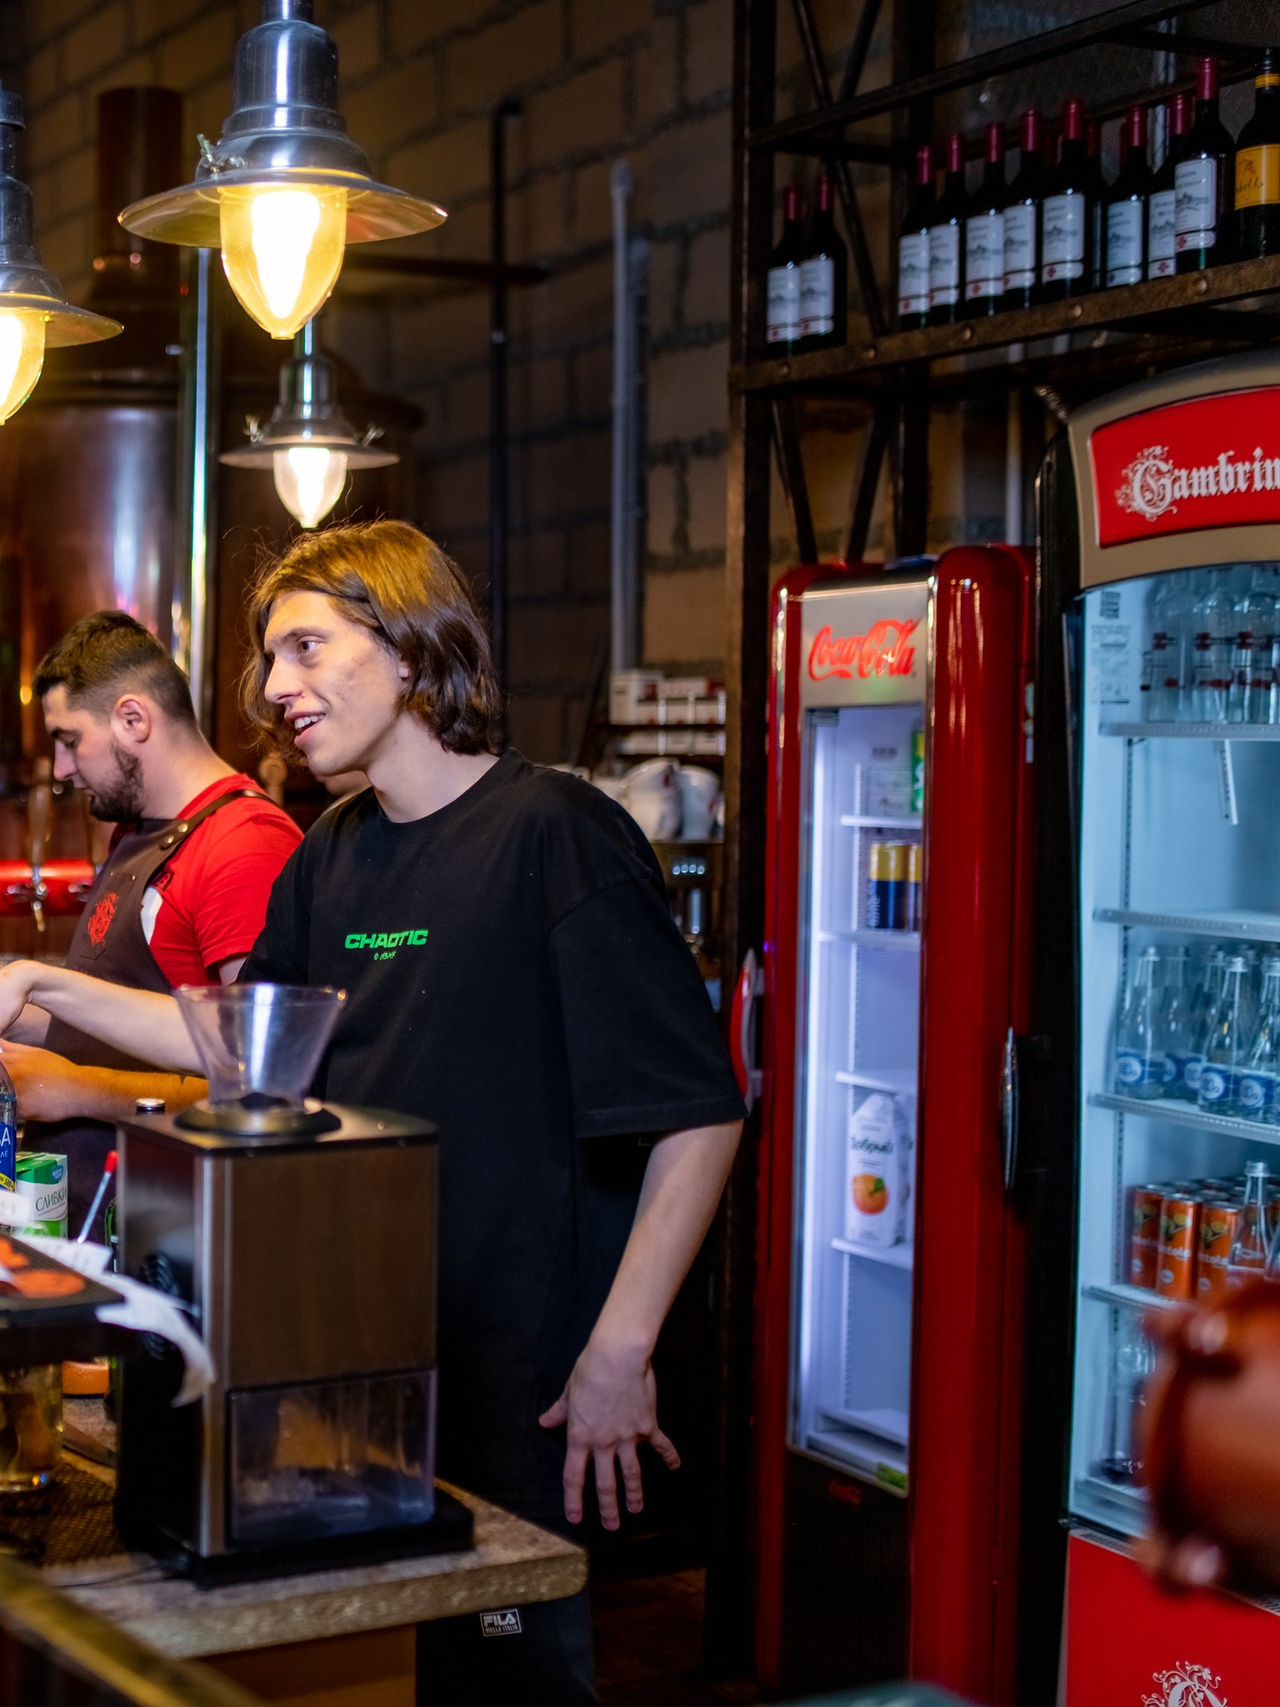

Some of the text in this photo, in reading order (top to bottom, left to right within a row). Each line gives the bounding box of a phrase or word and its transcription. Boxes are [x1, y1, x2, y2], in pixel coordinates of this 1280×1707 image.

[1115, 446, 1280, 522] Gambrin
[345, 930, 428, 949] CHAOTIC
[483, 1613, 517, 1627] FILA
